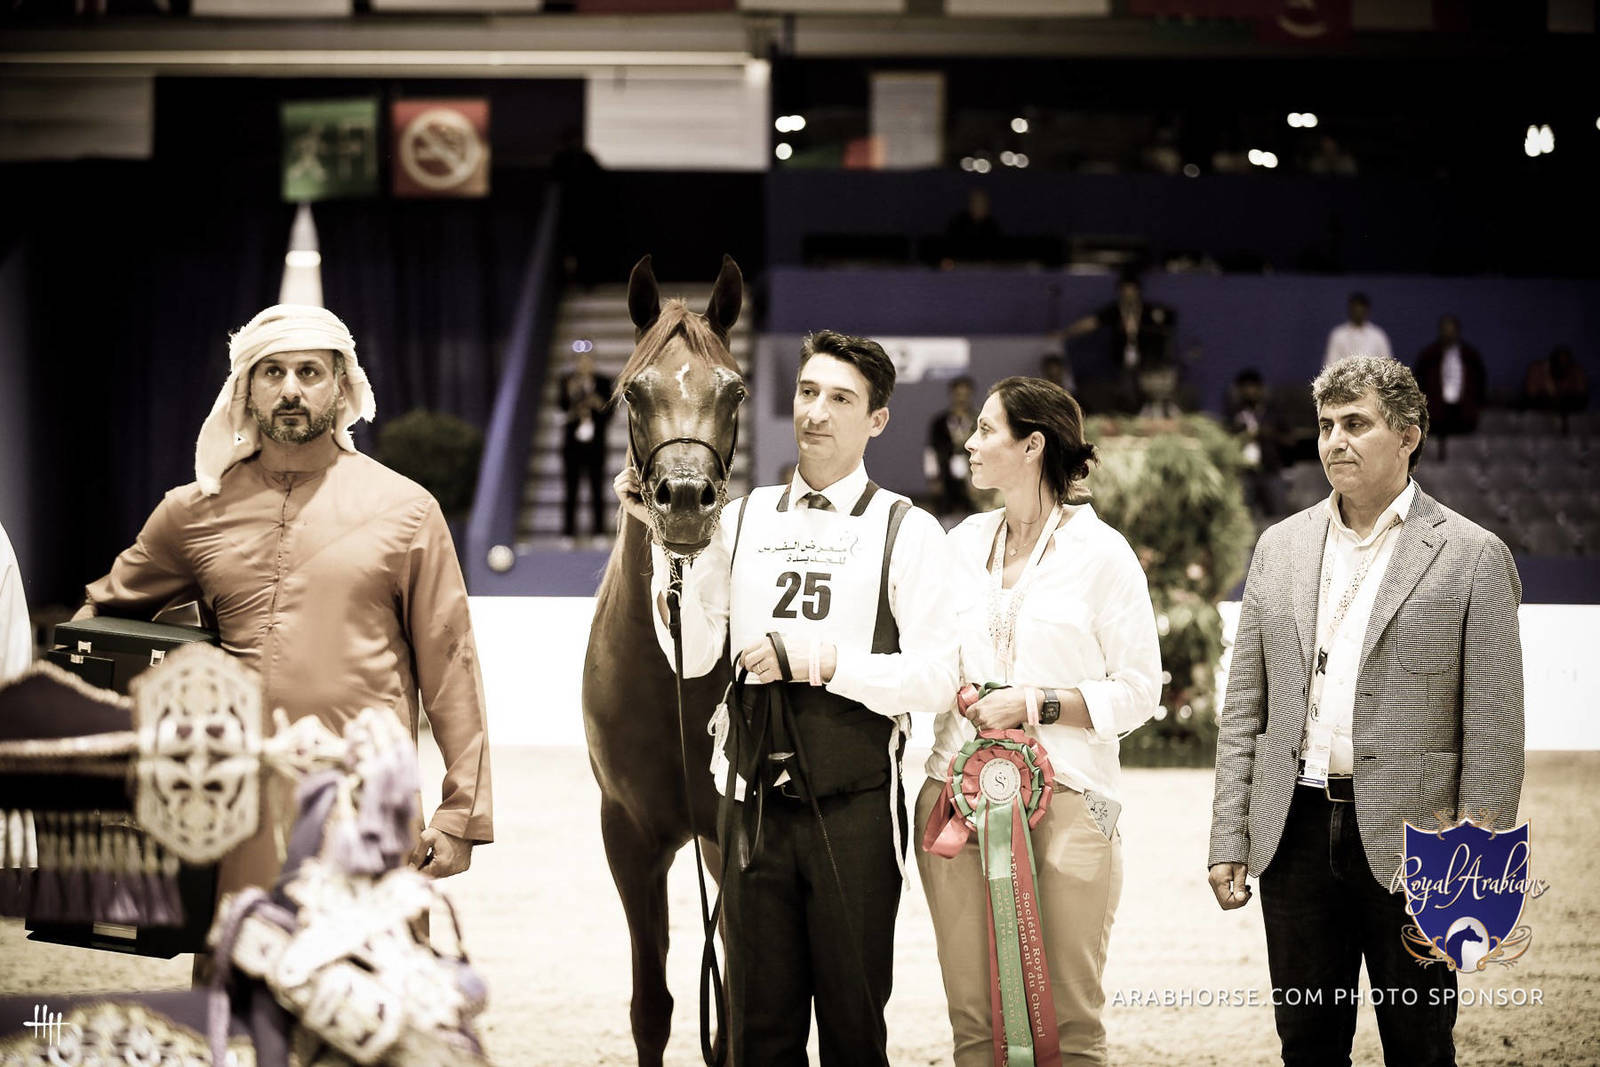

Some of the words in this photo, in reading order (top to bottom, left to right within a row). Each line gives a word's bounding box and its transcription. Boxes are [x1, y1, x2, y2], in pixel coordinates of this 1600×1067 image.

[772, 571, 831, 620] 25
[1022, 892, 1037, 942] Société
[1033, 947, 1047, 992] Royale
[1027, 972, 1036, 988] du
[1031, 993, 1046, 1038] Cheval
